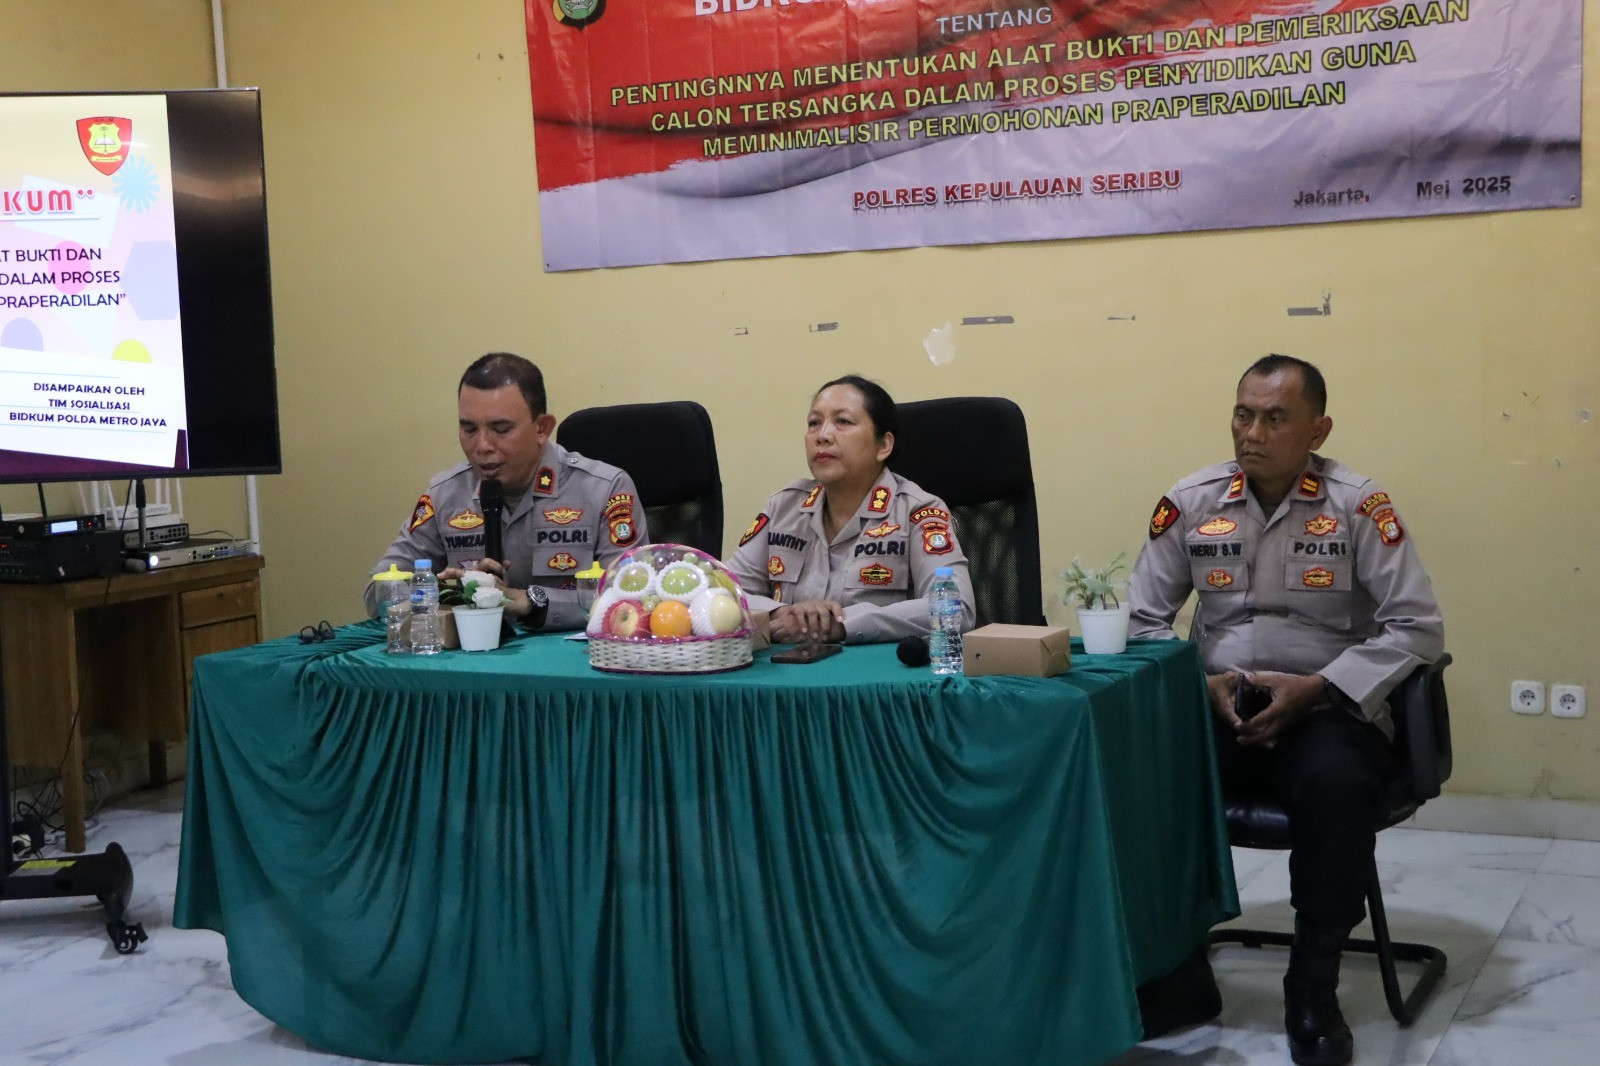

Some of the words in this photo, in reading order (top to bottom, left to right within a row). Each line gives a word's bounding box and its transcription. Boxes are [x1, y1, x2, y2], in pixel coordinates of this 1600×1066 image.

[936, 6, 1052, 34] TENTANG
[611, 70, 785, 106] PENTINGNNYA
[792, 49, 978, 88] MENENTUKAN
[987, 43, 1056, 68] ALAT
[1067, 32, 1154, 61] BUKTI
[1164, 26, 1226, 52] DAN
[1235, 0, 1470, 46] PEMERIKSAAN
[651, 106, 731, 135] CALON
[739, 90, 896, 124] TERSANGKA
[904, 80, 995, 108] DALAM
[1004, 69, 1116, 99] PROSES
[1125, 50, 1312, 90] PENYIDIKAN
[1321, 40, 1417, 71] GUNA
[703, 120, 900, 157] MEMINIMALISIR
[908, 102, 1103, 139] PERMOHONAN
[1112, 81, 1346, 124] PRAPERADILAN
[853, 186, 938, 209] POLRES
[944, 176, 1083, 203] KEPULAUAN
[1090, 169, 1182, 194] SERIBU
[1294, 187, 1370, 206] Jakarta,
[1416, 180, 1450, 197] Mei
[1462, 175, 1511, 193] 2025
[0, 250, 10, 262] T
[15, 248, 61, 262] BUKTI
[66, 247, 102, 261] DAN
[0, 272, 56, 286] DALAM
[61, 270, 120, 284] PROSES
[33, 382, 112, 395] DISAMPAIKAN
[114, 386, 145, 396] OLEH
[48, 398, 67, 408] TIM
[70, 399, 131, 411] SOSIALISASI
[9, 412, 55, 422] BIDKUM
[57, 414, 97, 424] POLDA
[99, 416, 138, 426] METRO
[140, 417, 167, 427] JAYA
[914, 509, 947, 520] POLDA
[537, 528, 588, 544] POLRI
[854, 541, 905, 558] POLRI
[1189, 543, 1217, 557] HERU
[1294, 541, 1346, 556] POLRI
